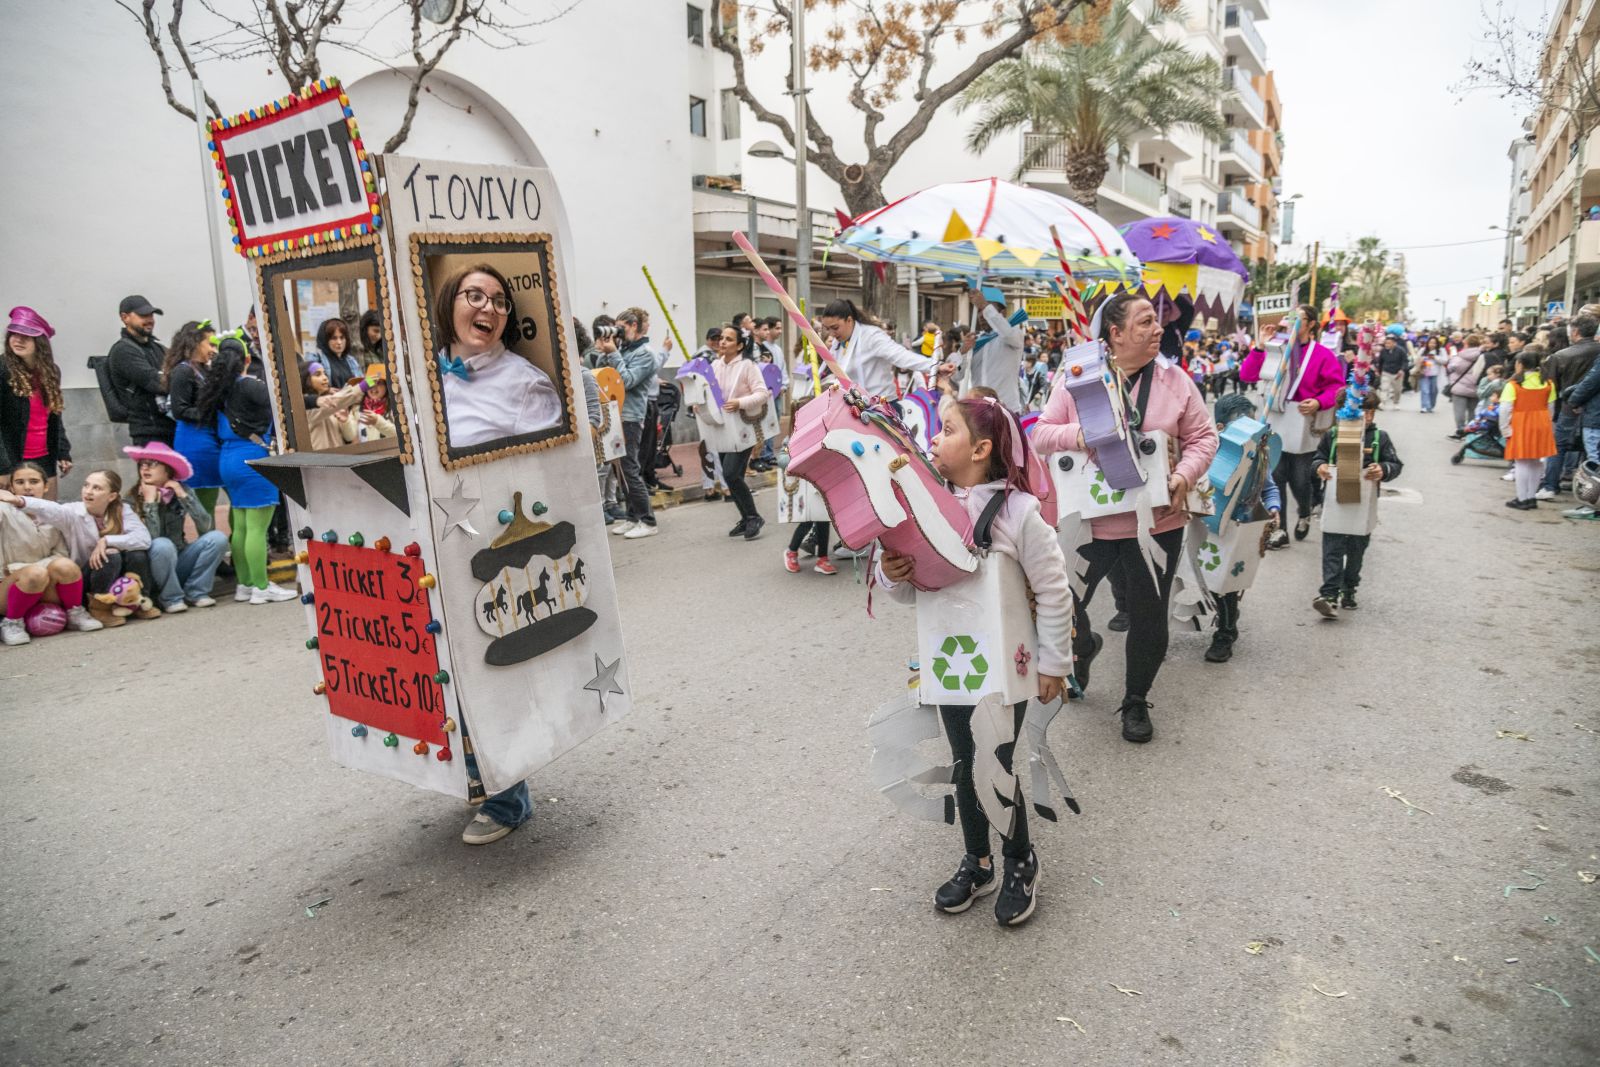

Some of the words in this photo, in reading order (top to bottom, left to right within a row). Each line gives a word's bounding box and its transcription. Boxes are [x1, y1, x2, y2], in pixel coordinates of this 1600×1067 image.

[225, 118, 362, 226] TICKET
[403, 162, 541, 222] TIOVIVO
[1256, 297, 1290, 310] TICKET
[315, 557, 326, 589] 1
[320, 602, 334, 636] 2
[324, 653, 340, 692] 5
